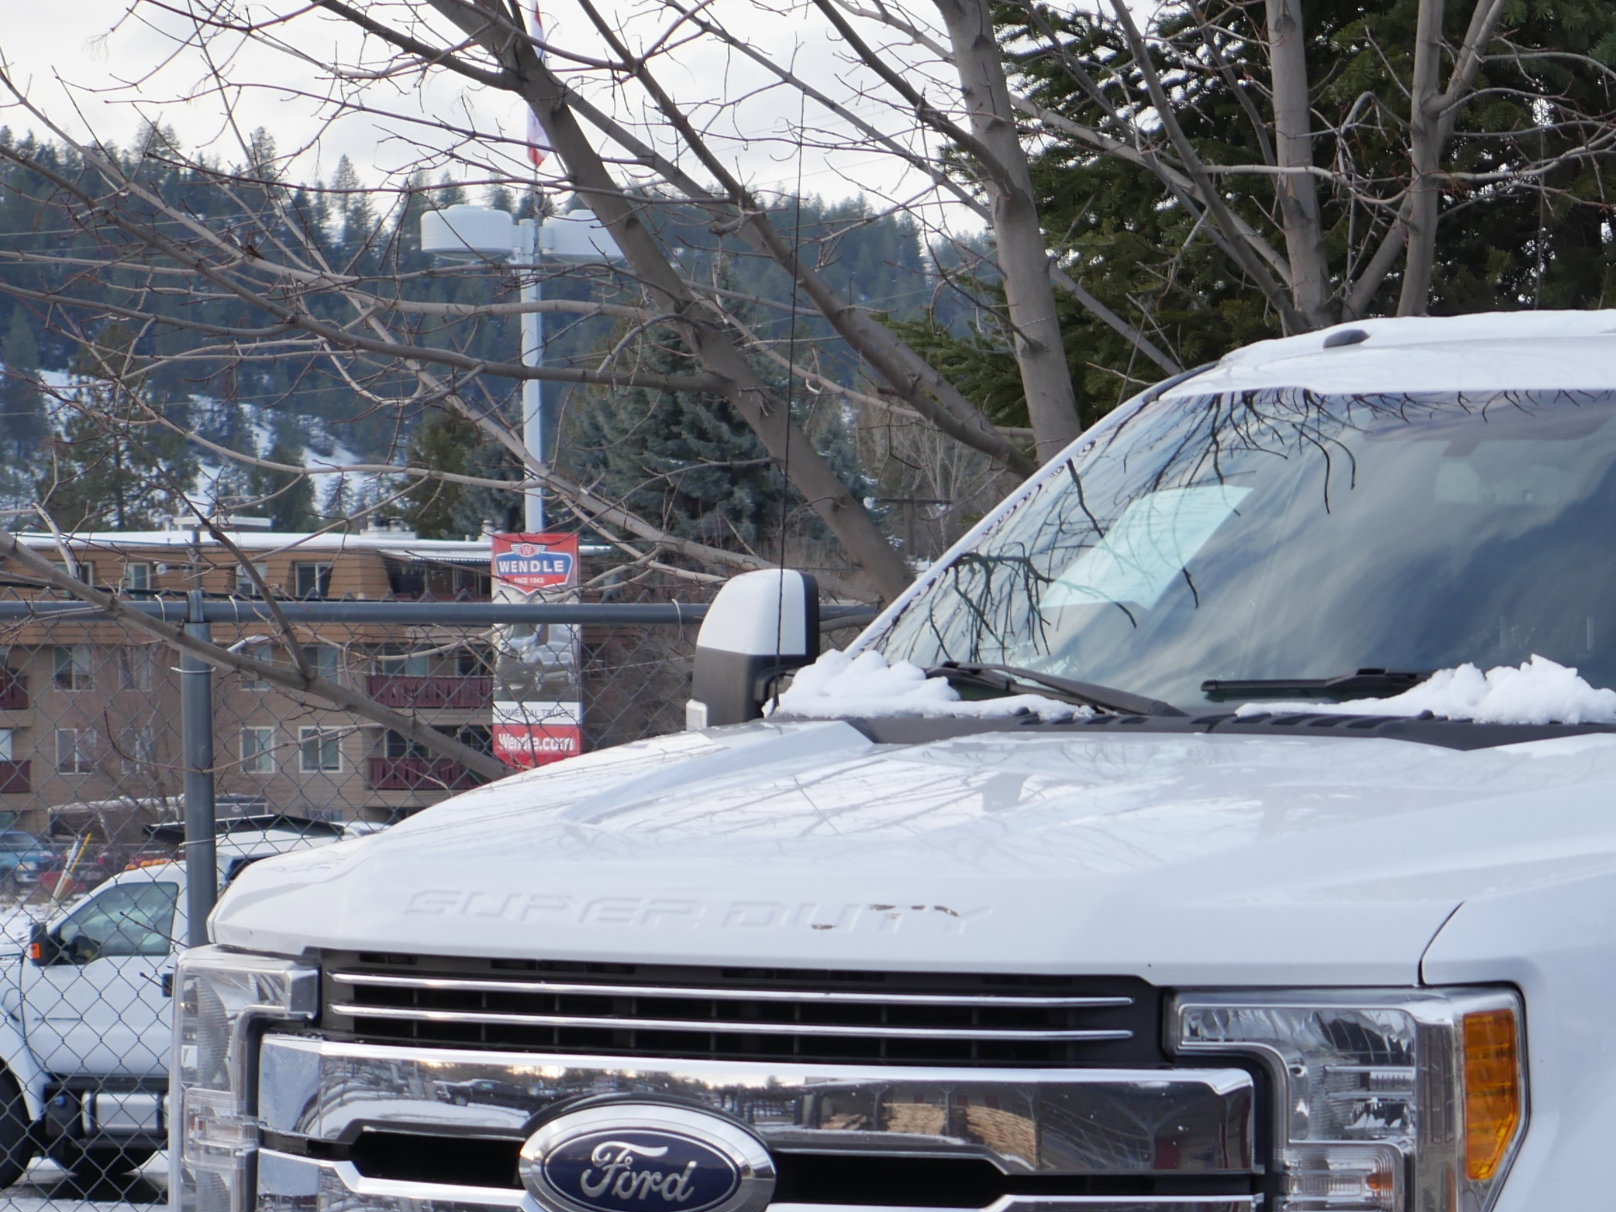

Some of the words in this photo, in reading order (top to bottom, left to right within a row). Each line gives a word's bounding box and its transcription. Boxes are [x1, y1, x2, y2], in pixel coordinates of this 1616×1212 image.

[499, 560, 564, 573] WENDLE
[403, 889, 706, 930] SUPER
[722, 898, 994, 935] DUTY
[580, 1140, 697, 1202] Ford
